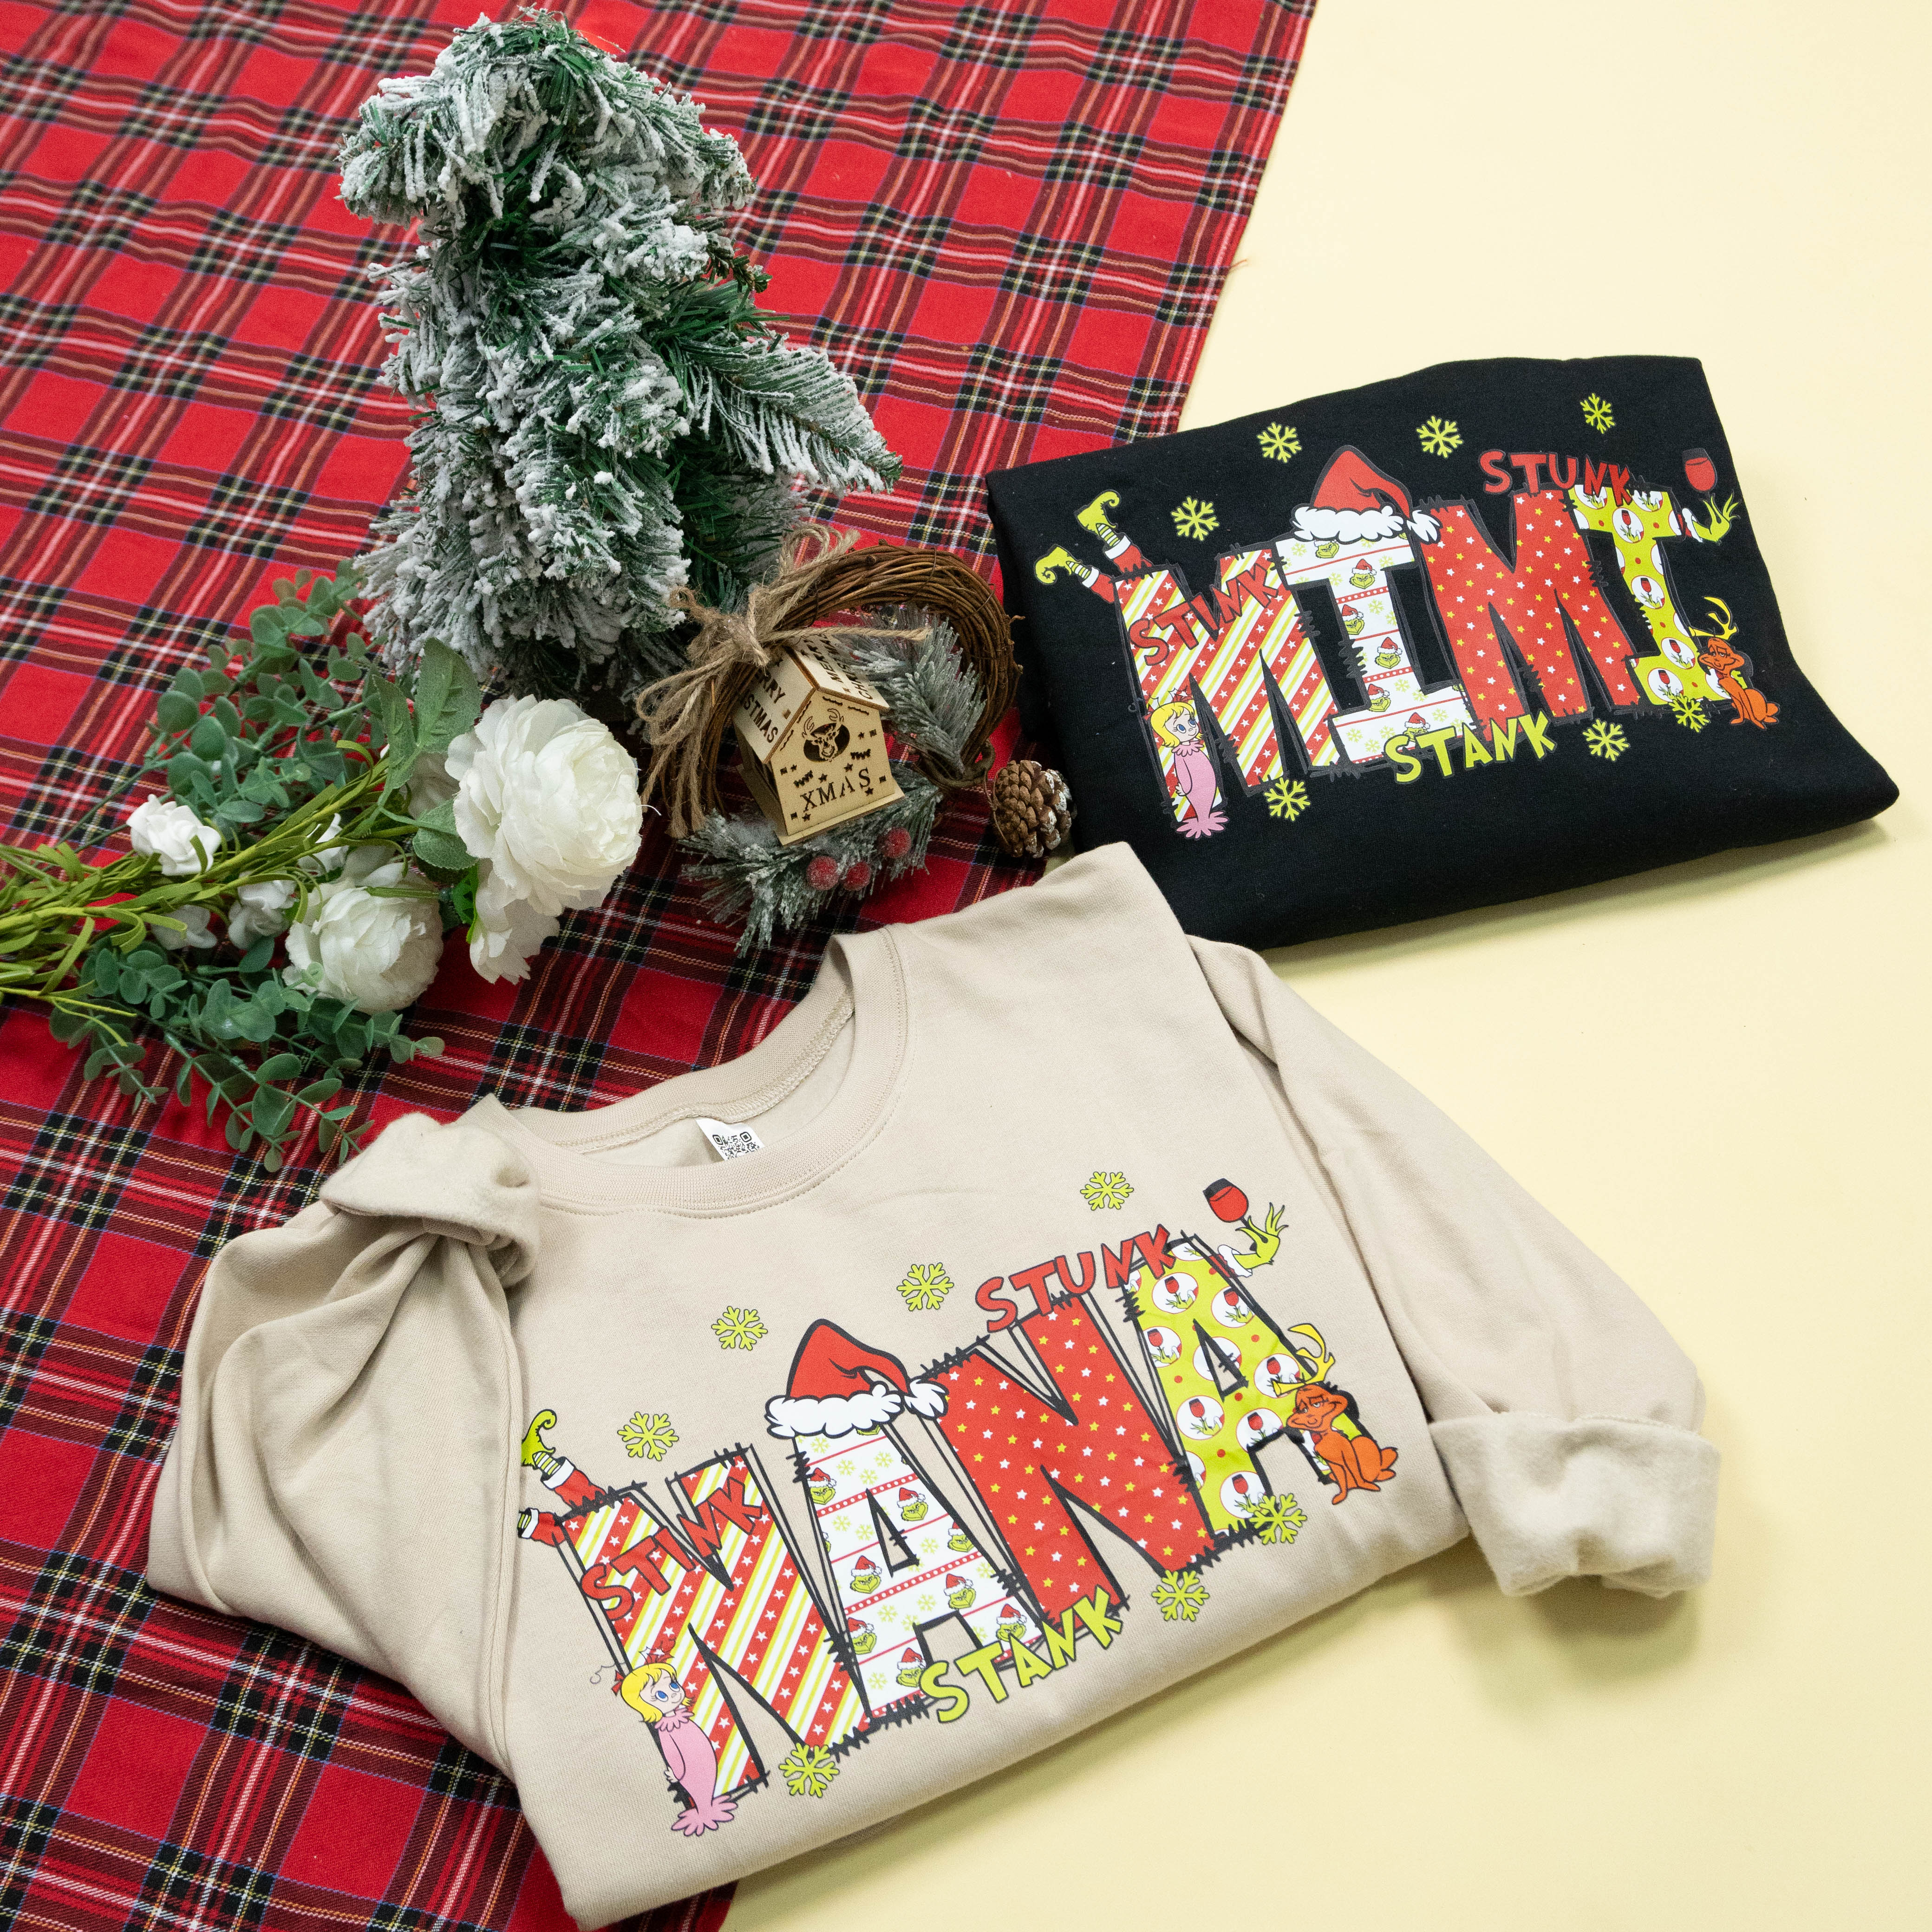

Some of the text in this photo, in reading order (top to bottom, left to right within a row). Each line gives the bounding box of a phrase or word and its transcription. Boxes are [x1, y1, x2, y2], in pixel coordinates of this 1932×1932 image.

[1478, 448, 1634, 506] STUNK
[1112, 477, 1753, 827] MIMI
[1129, 564, 1279, 667] STINK
[740, 692, 779, 743] STMAS
[1383, 711, 1557, 784] STANK
[800, 766, 871, 812] XMAS
[975, 1223, 1177, 1333] STUNK
[559, 1232, 1368, 1807] NANA
[581, 1475, 763, 1622] STINK
[920, 1584, 1123, 1723] STANK
